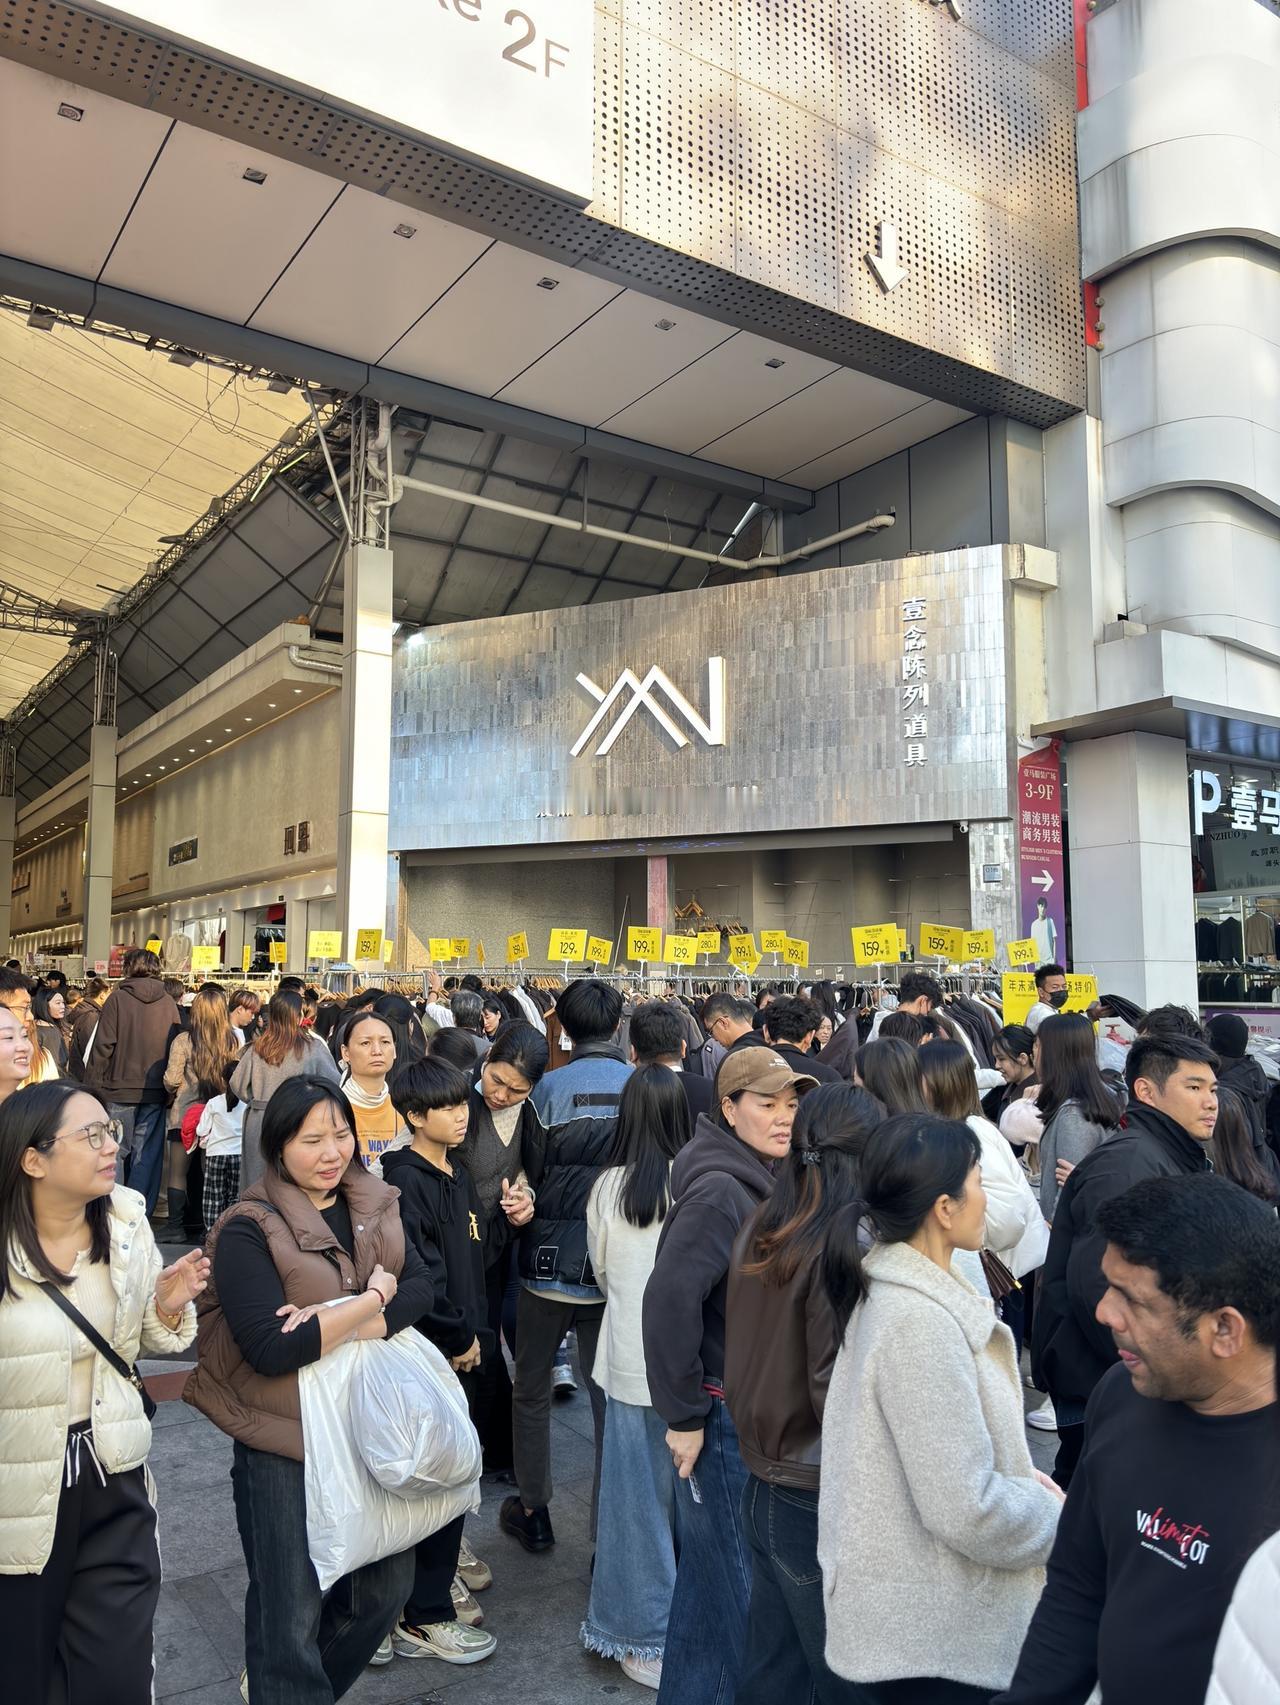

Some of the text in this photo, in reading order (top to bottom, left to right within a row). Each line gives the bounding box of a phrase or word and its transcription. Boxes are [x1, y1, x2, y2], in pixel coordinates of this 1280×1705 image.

[1025, 782, 1055, 801] 3-9F
[1022, 811, 1060, 828] 潮流男装
[1023, 827, 1061, 843] 商务男装
[560, 942, 575, 954] 129
[634, 940, 648, 953] 199
[673, 946, 688, 958] 129
[861, 941, 880, 957] 159
[968, 942, 981, 954] 159
[1008, 979, 1036, 993] 年末清
[1248, 1025, 1272, 1034] 馨提示
[368, 1139, 393, 1153] WAY
